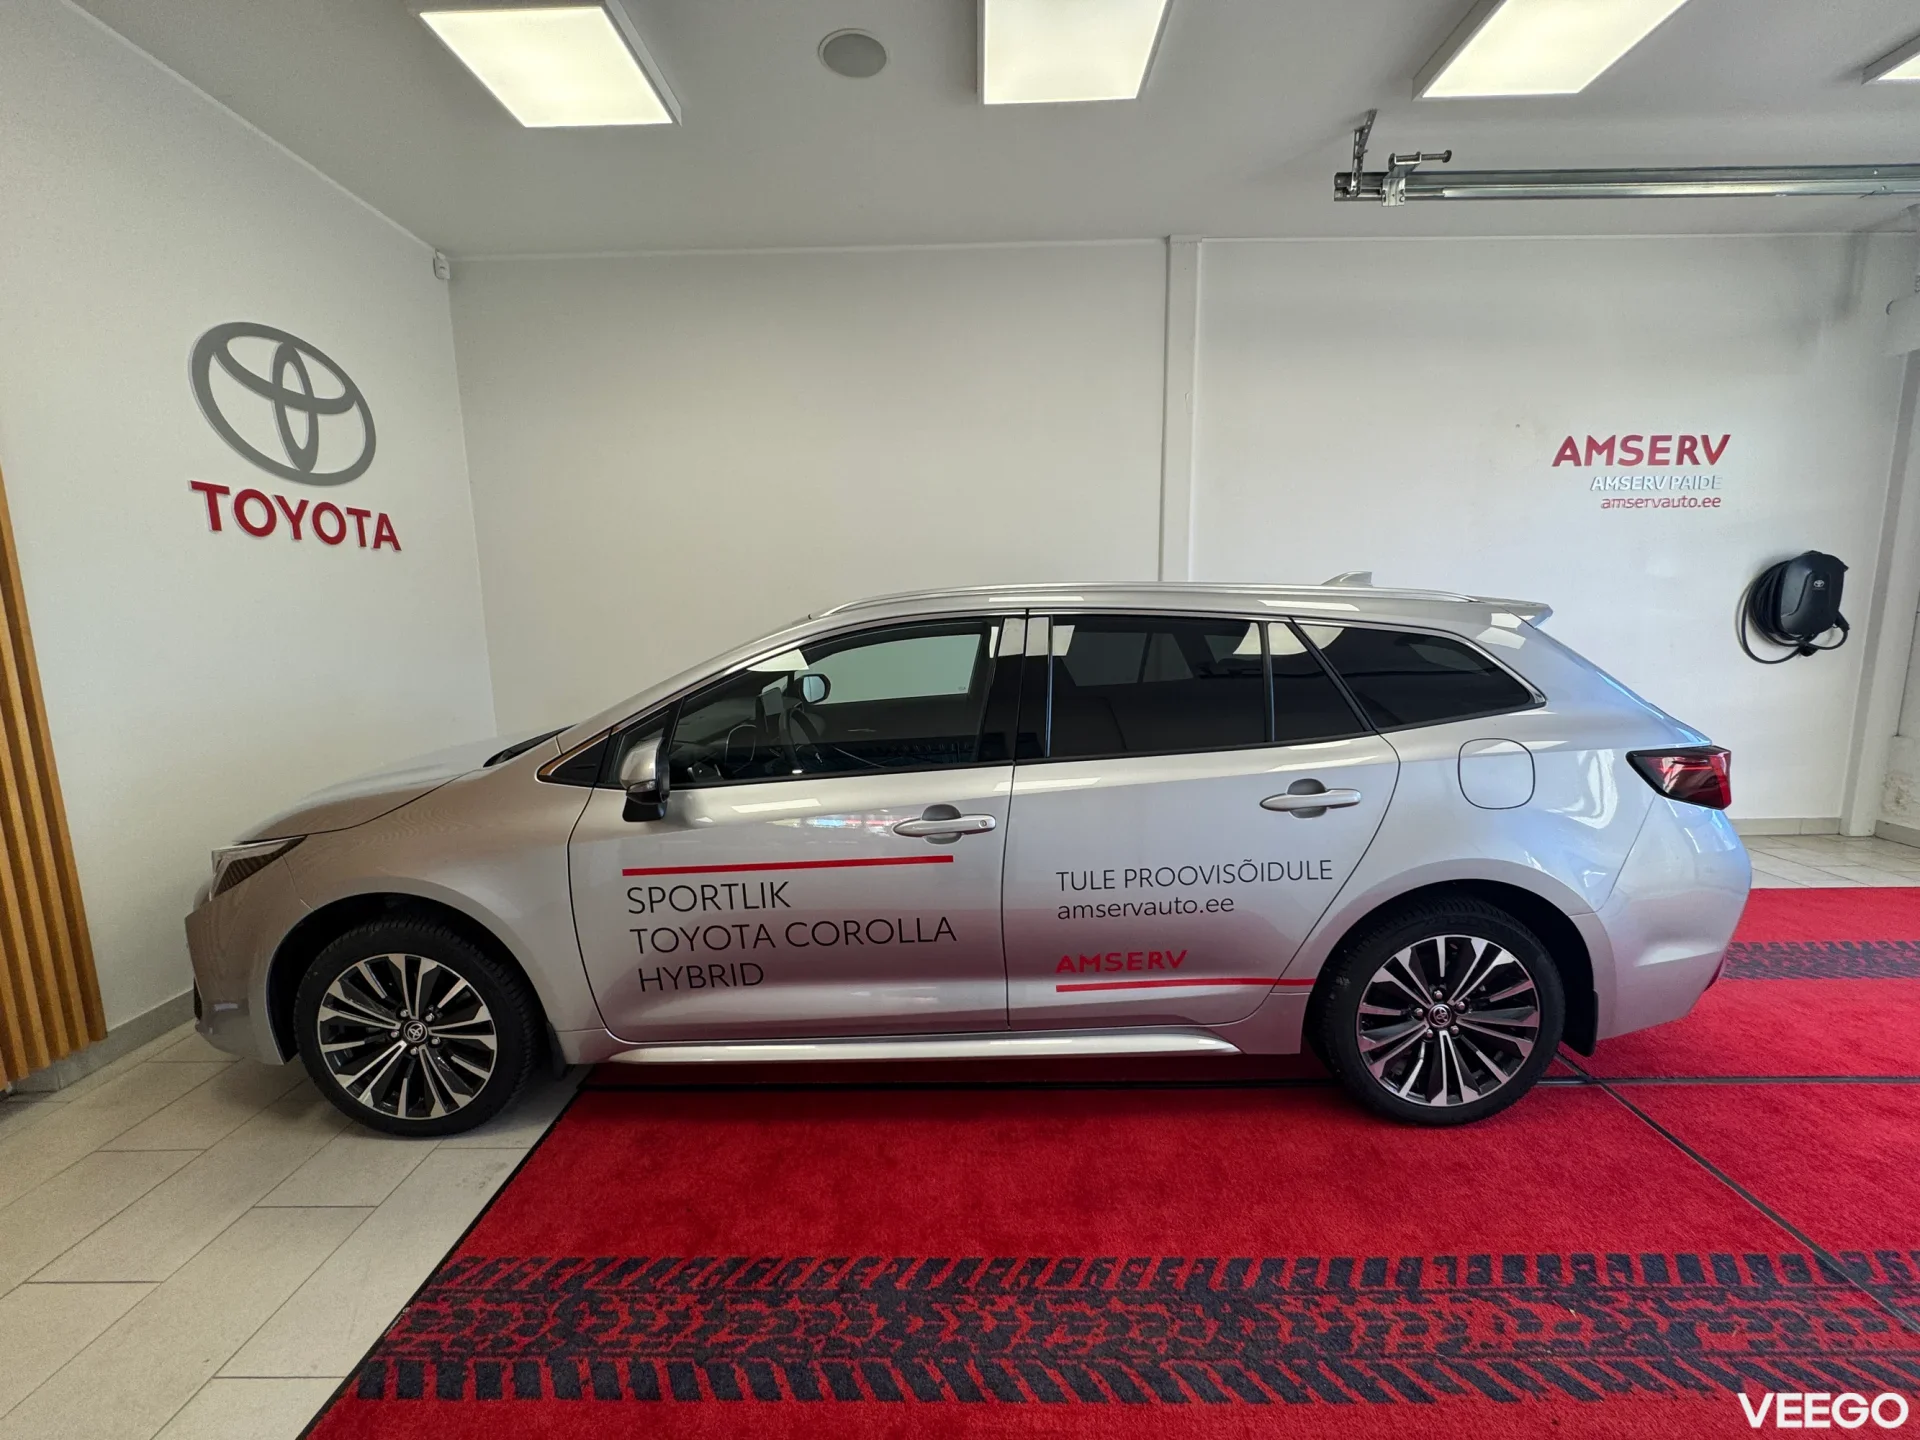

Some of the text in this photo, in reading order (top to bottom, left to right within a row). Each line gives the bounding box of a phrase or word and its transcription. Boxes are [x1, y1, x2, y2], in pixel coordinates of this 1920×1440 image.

[1552, 434, 1731, 467] AMSERV
[1590, 475, 1723, 491] AMSERV PAIDE
[188, 479, 402, 552] TOYOTA
[1600, 495, 1721, 509] amservauto.ee
[1056, 858, 1333, 892] TULE PROOVISÕIDULE
[627, 881, 791, 914] SPORTLIK
[1057, 896, 1235, 920] amservauto.ee
[629, 916, 957, 954] TOYOTA COROLLA
[637, 962, 764, 992] HYBRID
[1055, 949, 1188, 974] AMSERV
